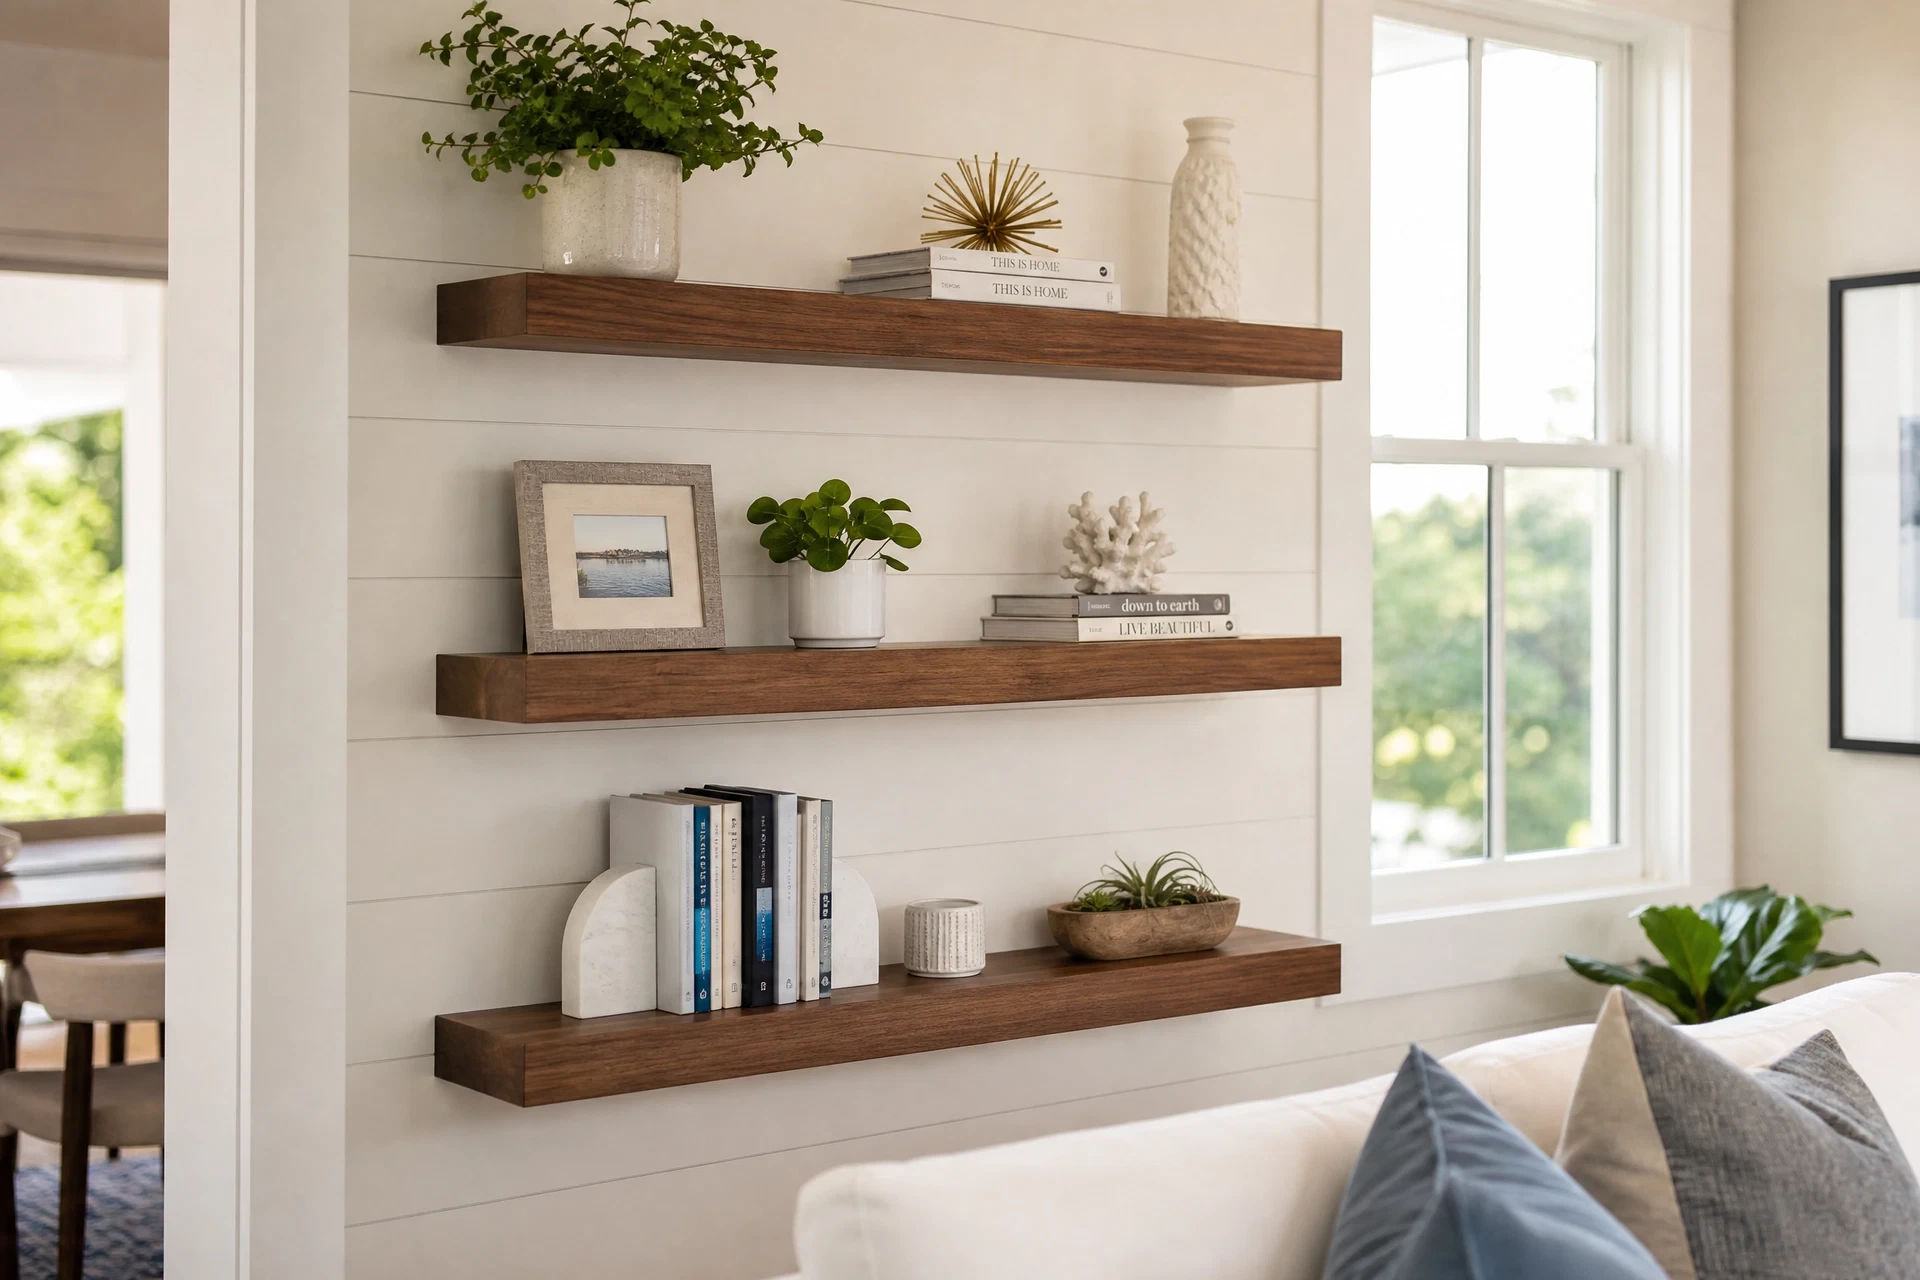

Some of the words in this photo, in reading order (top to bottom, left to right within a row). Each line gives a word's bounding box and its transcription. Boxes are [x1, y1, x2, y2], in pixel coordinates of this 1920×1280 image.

[991, 256, 1015, 269] THIS
[1018, 259, 1027, 270] IS
[1029, 260, 1060, 273] HOME
[992, 282, 1020, 296] THIS
[1022, 285, 1032, 297] IS
[1034, 286, 1068, 300] HOME
[1121, 598, 1154, 612] down
[1156, 600, 1168, 612] to
[1169, 597, 1200, 612] earth
[1119, 622, 1147, 636] LIVE
[1150, 620, 1216, 635] BEAUTIFUL
